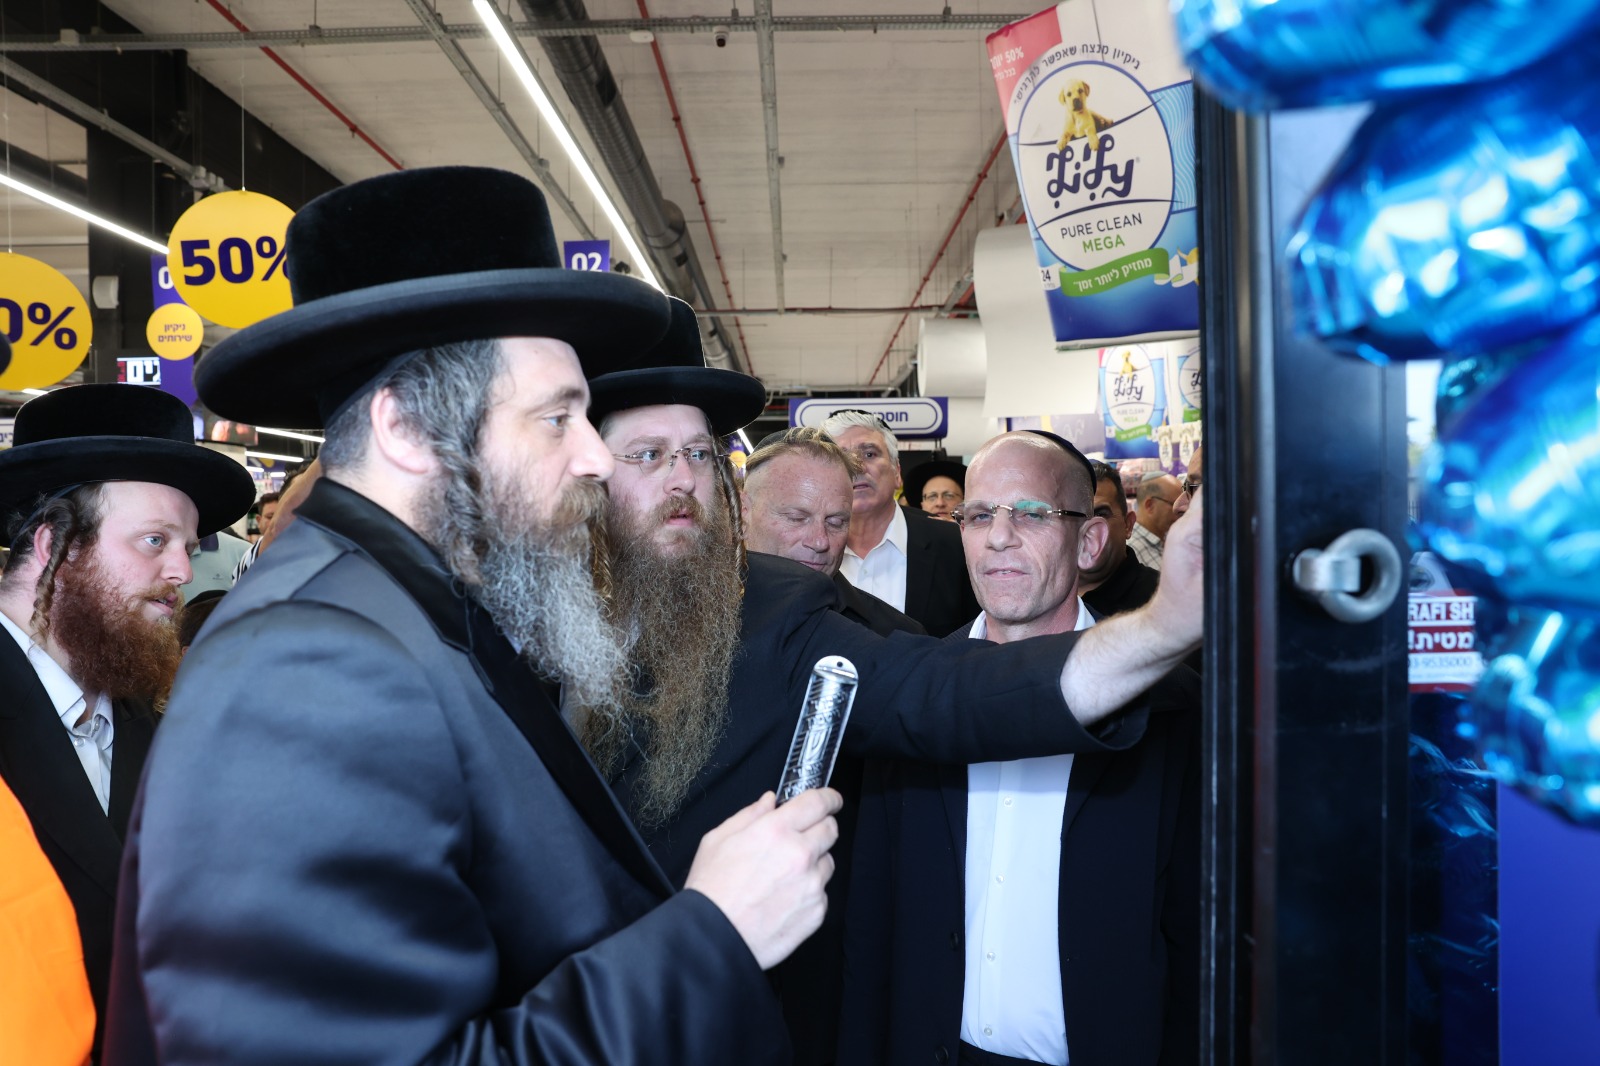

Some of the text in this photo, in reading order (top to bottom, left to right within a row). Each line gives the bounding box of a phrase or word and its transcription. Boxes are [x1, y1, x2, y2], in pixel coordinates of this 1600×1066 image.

[1005, 46, 1025, 64] 50%
[1041, 45, 1077, 67] שאפשר
[1081, 43, 1109, 55] מנצח
[1112, 47, 1141, 69] ניקיון
[1060, 212, 1143, 239] PURE CLEAN
[1082, 234, 1126, 253] MEGA
[180, 236, 289, 286] 50%
[571, 251, 603, 272] 02
[1121, 257, 1153, 278] מחזיק
[1094, 268, 1120, 287] ליותר
[164, 323, 186, 333] ניקיון
[157, 334, 193, 343] שירותים
